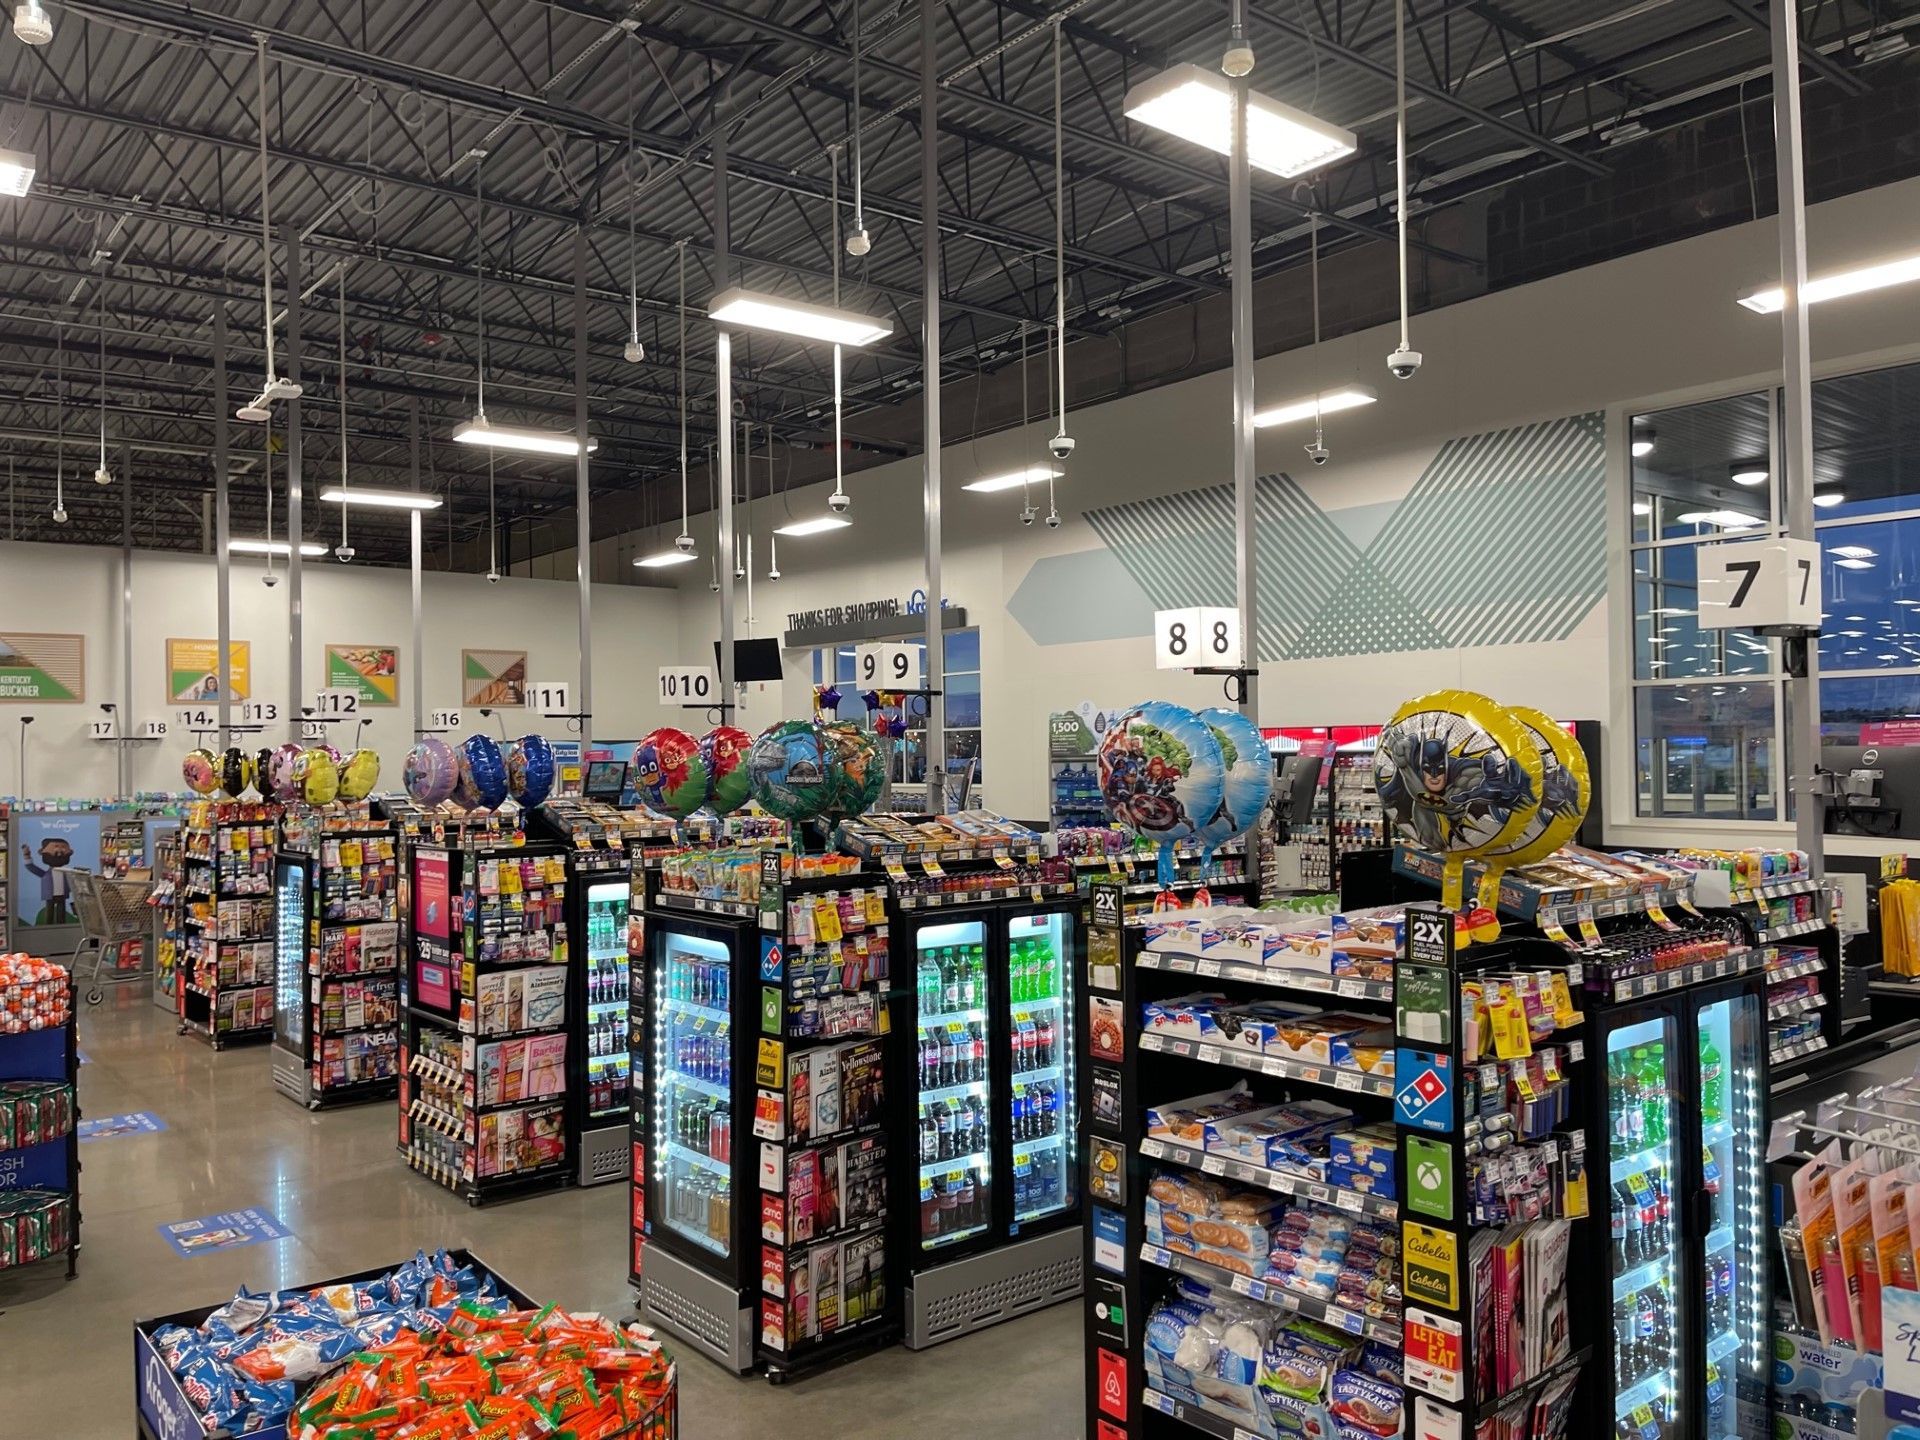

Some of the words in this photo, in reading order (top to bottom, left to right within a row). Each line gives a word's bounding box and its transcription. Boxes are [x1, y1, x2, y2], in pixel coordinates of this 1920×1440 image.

[1725, 561, 1761, 608] 7
[1797, 559, 1811, 606] 7
[787, 609, 824, 631] THANKS
[825, 606, 843, 626] FOR
[844, 598, 899, 624] SHOPPING!
[1169, 622, 1187, 655] 8
[1213, 620, 1229, 654] 8
[863, 654, 875, 681] 9
[893, 653, 909, 679] 9
[0, 675, 31, 685] KENTUCKY
[660, 675, 676, 697] 10
[680, 674, 709, 697] 10
[0, 684, 39, 698] BUCKNER
[358, 693, 374, 701] ASTE
[526, 689, 537, 709] 11
[541, 688, 566, 708] 11
[253, 703, 277, 720] 13
[330, 694, 356, 713] 12
[183, 711, 206, 725] 14
[431, 713, 439, 725] 16
[441, 712, 459, 726] 16
[93, 722, 111, 734] 17
[149, 722, 167, 734] 18
[1051, 721, 1080, 735] 1,500
[632, 848, 641, 858] 2X
[764, 858, 778, 872] 2X
[1095, 892, 1117, 911] 2X
[1420, 913, 1438, 922] EARN
[324, 934, 345, 943] MARV
[1413, 921, 1444, 945] 2X
[1413, 951, 1431, 959] EVERY
[1426, 943, 1444, 951] POINTS
[364, 983, 376, 993] air
[376, 982, 396, 993] fryer
[530, 978, 564, 989] Alzheimer's
[364, 1031, 397, 1047] NBA
[532, 1043, 564, 1059] Barbie
[841, 1051, 882, 1072] Yellowstone
[1094, 1077, 1119, 1090] ROBLOX
[528, 1109, 547, 1120] Santa
[765, 1109, 778, 1121] EAT
[862, 1139, 873, 1150] LIFE
[847, 1148, 887, 1169] HAUNTED
[847, 1234, 884, 1262] HORSES
[1408, 1237, 1450, 1261] Cabela's
[1409, 1270, 1448, 1293] Cabela's
[1153, 1315, 1185, 1338] TASTYKAKE
[1412, 1324, 1446, 1348] LET'S
[1265, 1354, 1316, 1378] TASTYKAKE
[1428, 1345, 1457, 1369] EAT
[1800, 1349, 1842, 1369] water
[1337, 1384, 1392, 1413] TASTYKAKE
